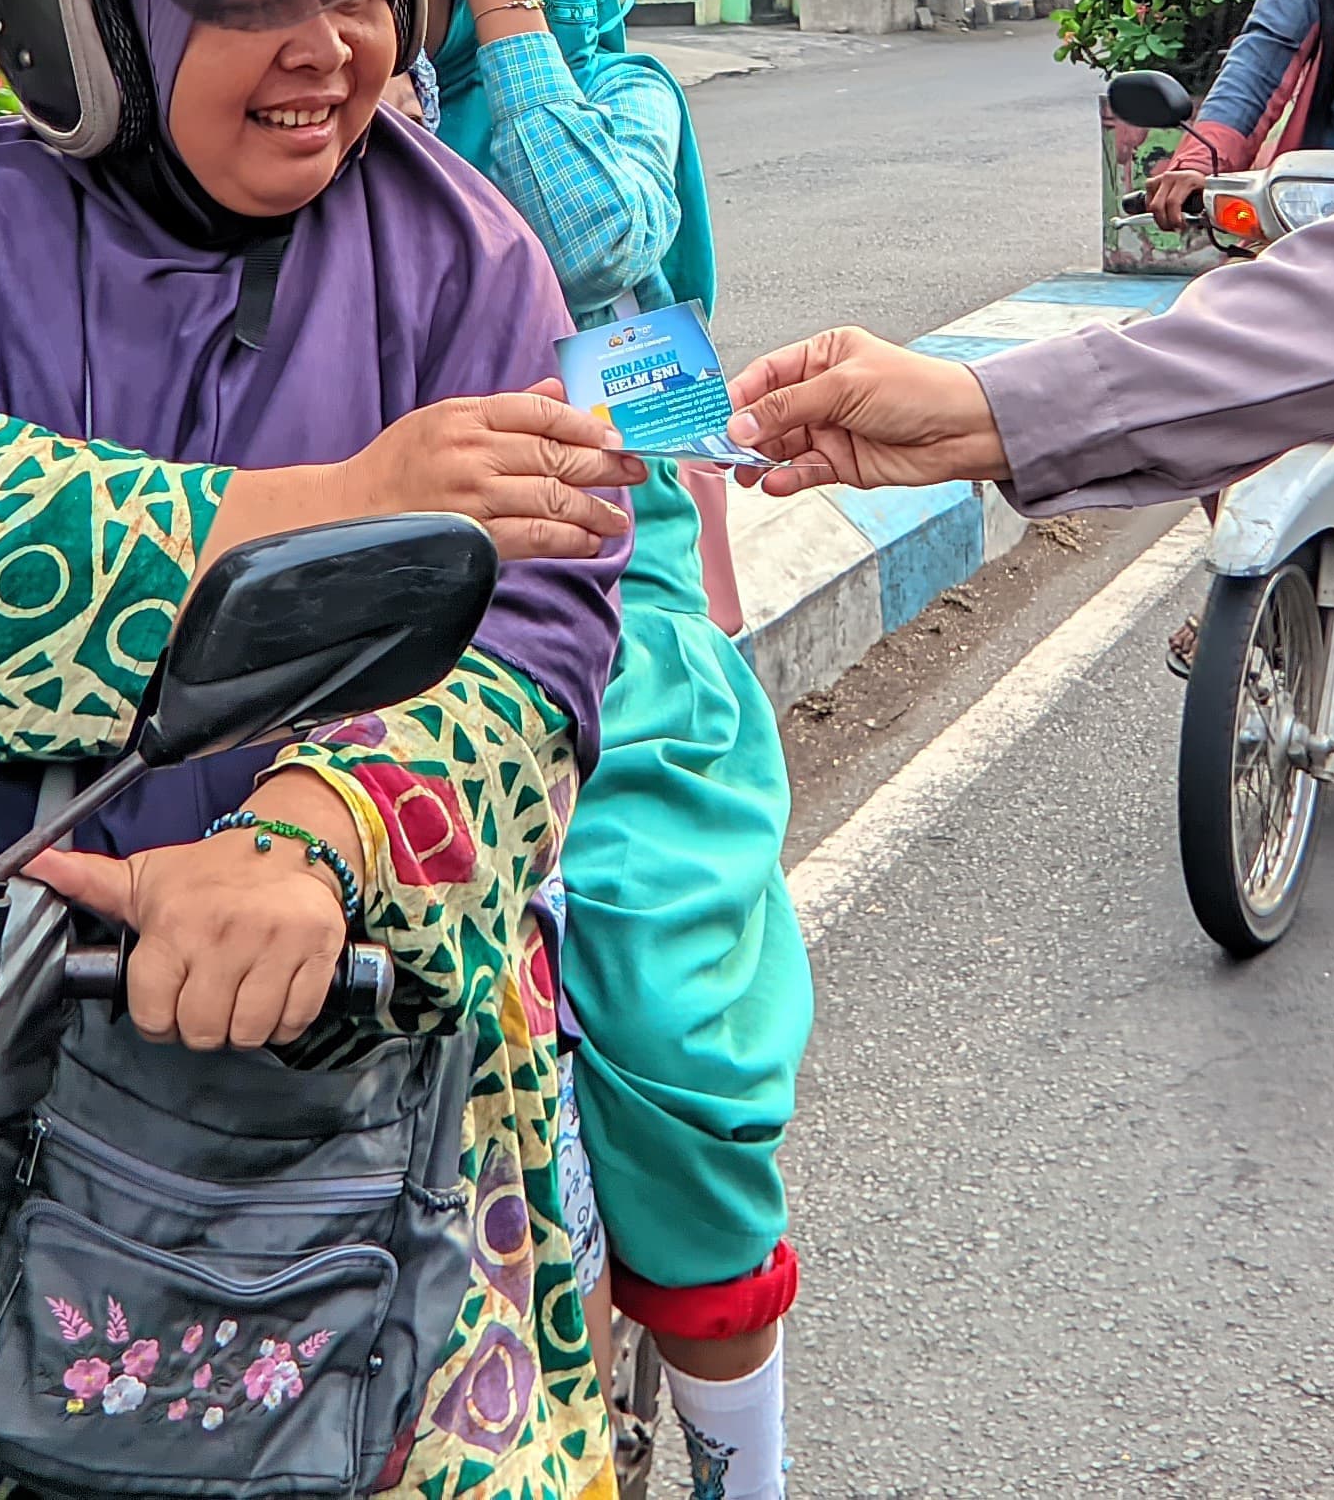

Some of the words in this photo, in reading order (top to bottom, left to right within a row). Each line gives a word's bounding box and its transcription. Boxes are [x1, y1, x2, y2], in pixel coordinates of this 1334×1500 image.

[600, 350, 678, 381] GUNAKAN
[606, 371, 651, 395] HELM
[651, 363, 680, 380] SNI
